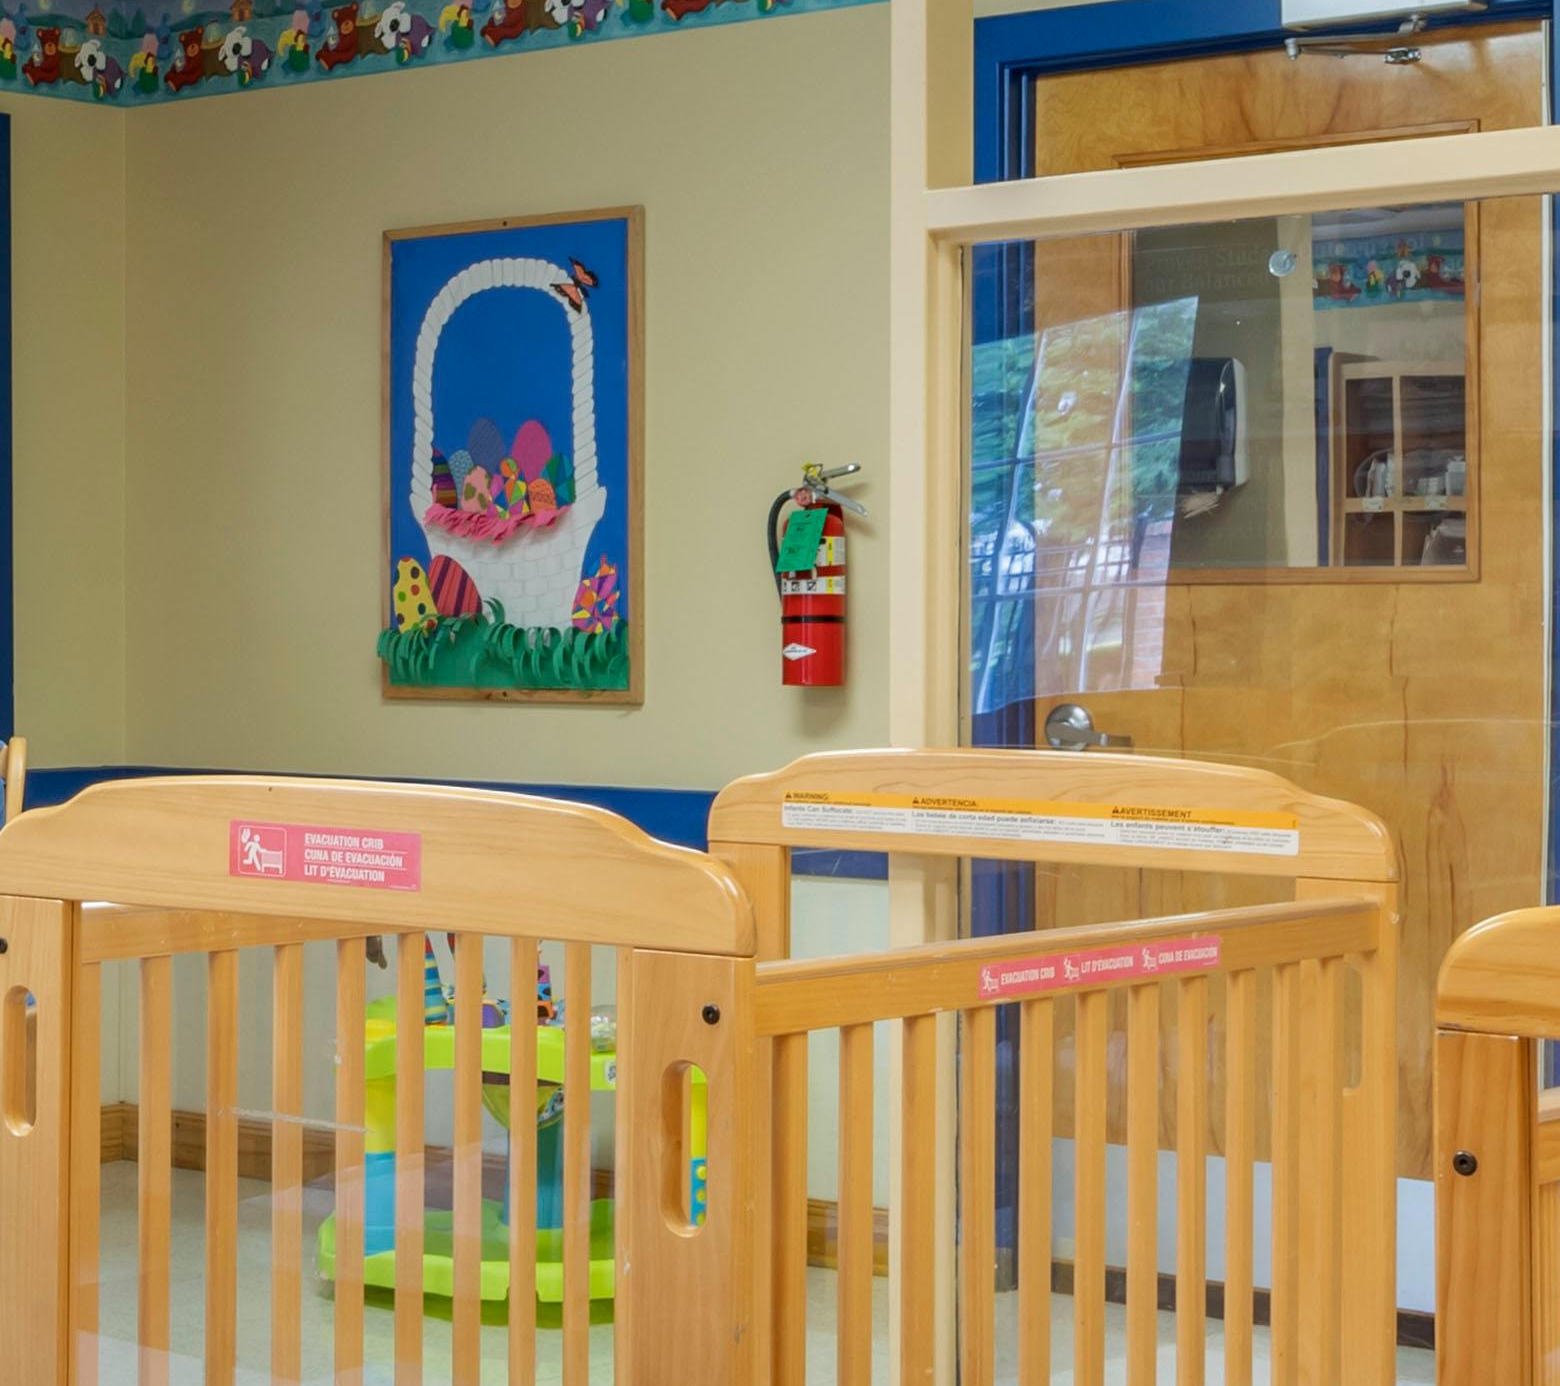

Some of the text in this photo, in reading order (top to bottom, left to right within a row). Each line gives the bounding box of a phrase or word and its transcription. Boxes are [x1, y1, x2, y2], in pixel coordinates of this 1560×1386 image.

[978, 813, 995, 821] edad
[996, 816, 1018, 824] puede
[1126, 822, 1154, 830] enfants
[1155, 824, 1185, 832] peuvent
[304, 833, 384, 850] EVACUATION CRIB
[304, 848, 403, 869] CUNA DE EVACUACIÓN
[304, 864, 318, 877] LIT
[1174, 950, 1183, 962] DE
[1081, 961, 1091, 973] LIT
[1001, 966, 1056, 986] EVACUATION CRIB
